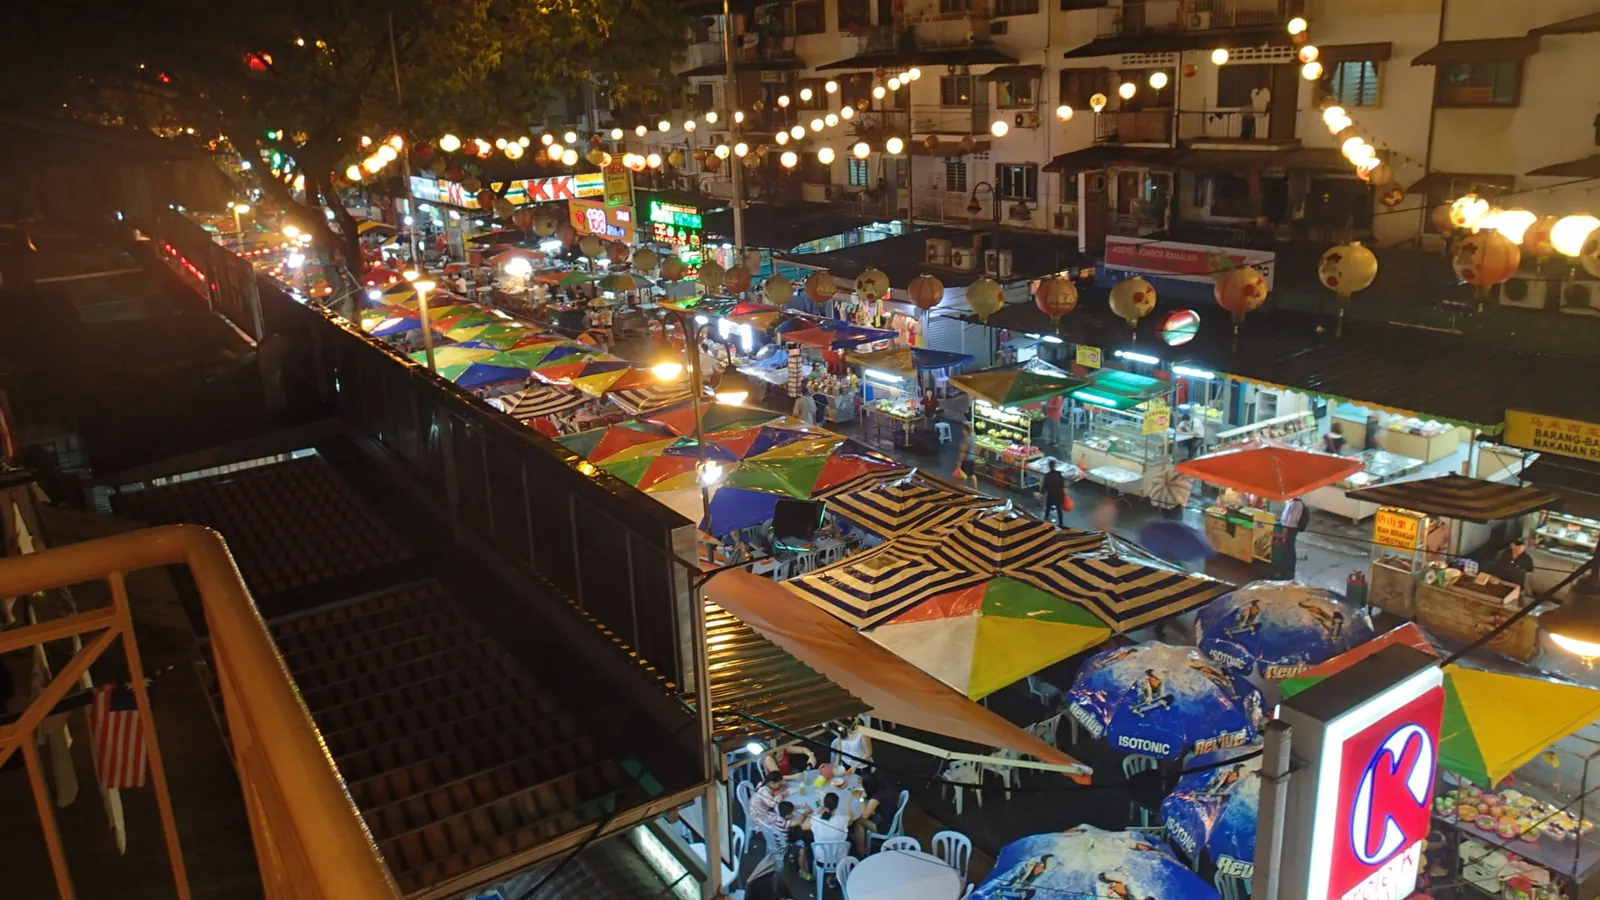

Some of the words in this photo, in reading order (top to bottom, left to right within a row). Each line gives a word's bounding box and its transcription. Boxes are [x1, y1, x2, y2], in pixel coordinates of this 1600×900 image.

[527, 176, 574, 201] KK
[1533, 438, 1587, 456] MAKANAN
[1209, 648, 1246, 670] ISOTONIC
[1069, 701, 1105, 738] Revive
[1118, 735, 1170, 755] ISOTONIC
[1195, 728, 1247, 756] Revive
[1165, 816, 1197, 853] ISOTONIC
